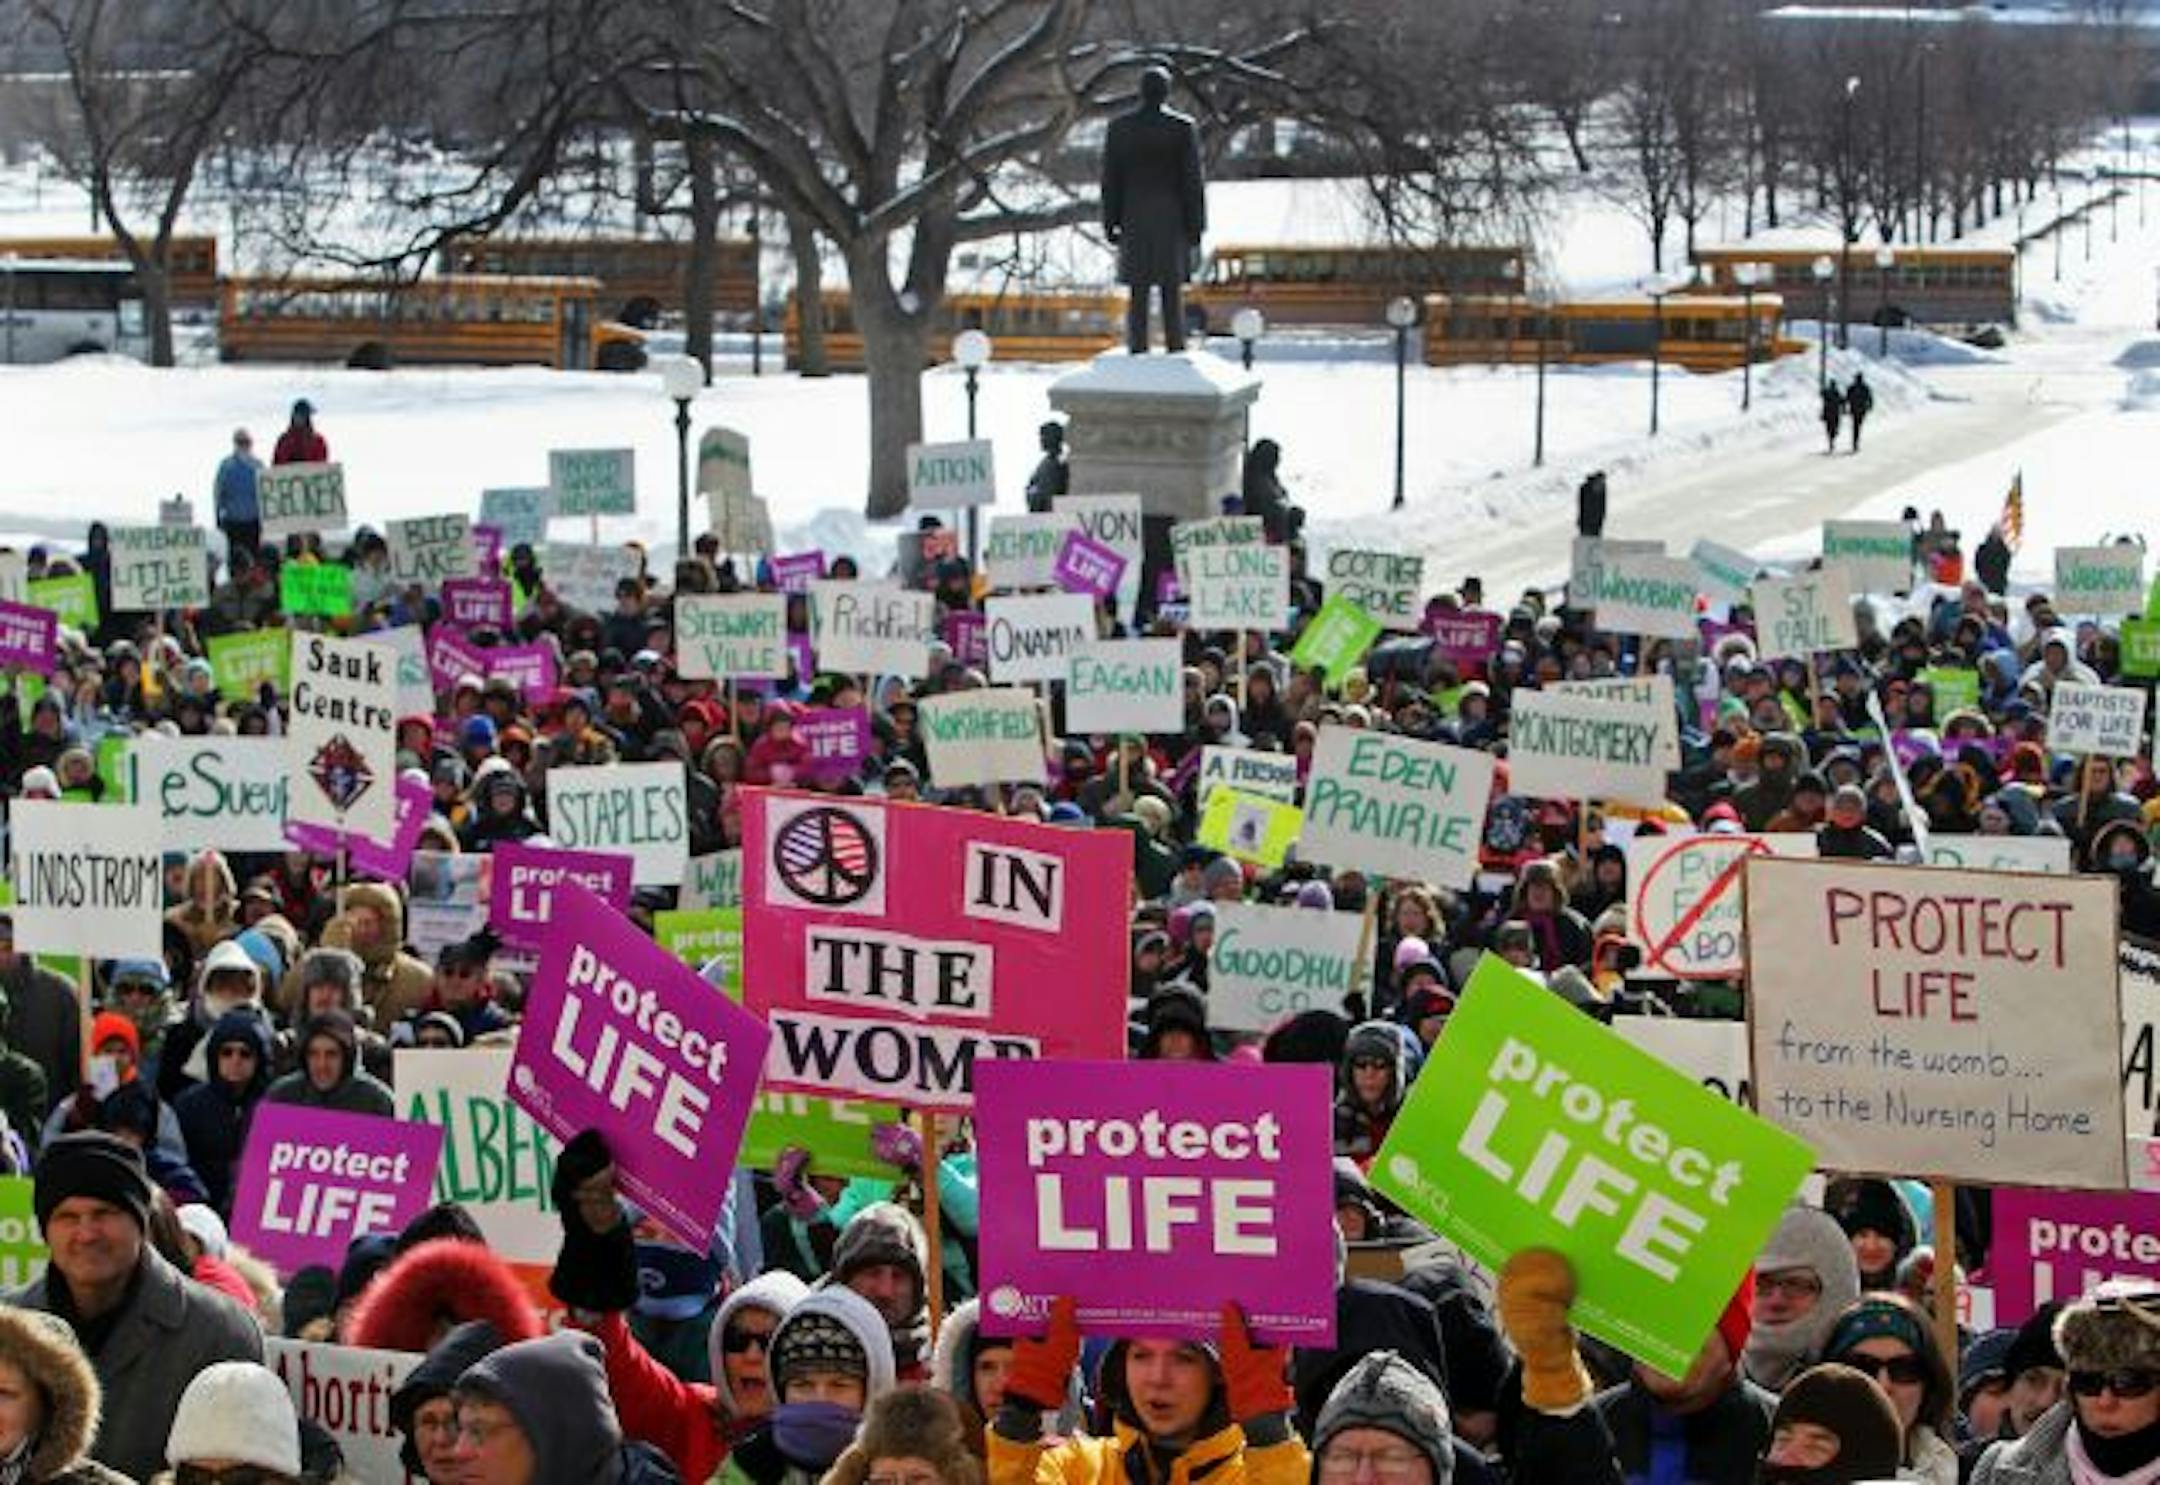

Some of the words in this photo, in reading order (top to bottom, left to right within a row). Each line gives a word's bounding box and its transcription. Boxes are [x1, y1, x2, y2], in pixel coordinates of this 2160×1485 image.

[261, 468, 346, 519] BECKER
[914, 455, 987, 487] AITKIN
[404, 516, 463, 548] BIG
[1077, 510, 1138, 542] VON
[115, 557, 190, 590] LITTLE
[393, 548, 466, 578] LAKE
[1204, 548, 1279, 578] LONG
[454, 602, 502, 622] LIFE
[1202, 586, 1277, 618] LAKE
[1782, 584, 1815, 616] ST
[0, 628, 46, 653] IFE
[1774, 614, 1837, 650] PAUL
[307, 638, 382, 686] Sauk
[704, 643, 776, 673] VILLE
[1071, 657, 1176, 697] EAGAN
[294, 681, 393, 731] Centre
[2056, 713, 2093, 733] FOR
[2101, 715, 2136, 737] LIFE
[813, 735, 859, 758] IFE
[1511, 711, 1659, 767] MONTGOMERY
[1205, 766, 1225, 788] A
[1349, 738, 1457, 794] EDEN
[557, 786, 684, 847] STAPLES
[1311, 778, 1473, 854] PRAIRIE
[17, 852, 160, 908] LINDSTROM
[975, 849, 1058, 919] IN
[1826, 887, 2074, 968] PROTECT
[813, 937, 976, 1010] THE
[1872, 969, 1978, 1023] LIFE
[567, 943, 729, 1085] protect
[776, 1019, 1034, 1093] WOM
[1776, 1023, 1855, 1064] from
[1869, 1031, 1915, 1069] the
[551, 993, 711, 1160] LIFE
[1027, 1108, 1281, 1166] protect
[1486, 1036, 1745, 1207] protect
[1777, 1090, 1814, 1120] to
[1819, 1087, 1873, 1123] the
[1884, 1096, 1997, 1147] Nursing
[2008, 1094, 2095, 1135] Home
[269, 1140, 410, 1184] protect
[1456, 1088, 1708, 1285] LIFE
[258, 1180, 397, 1237] LIFE
[1036, 1173, 1278, 1258] LIFE
